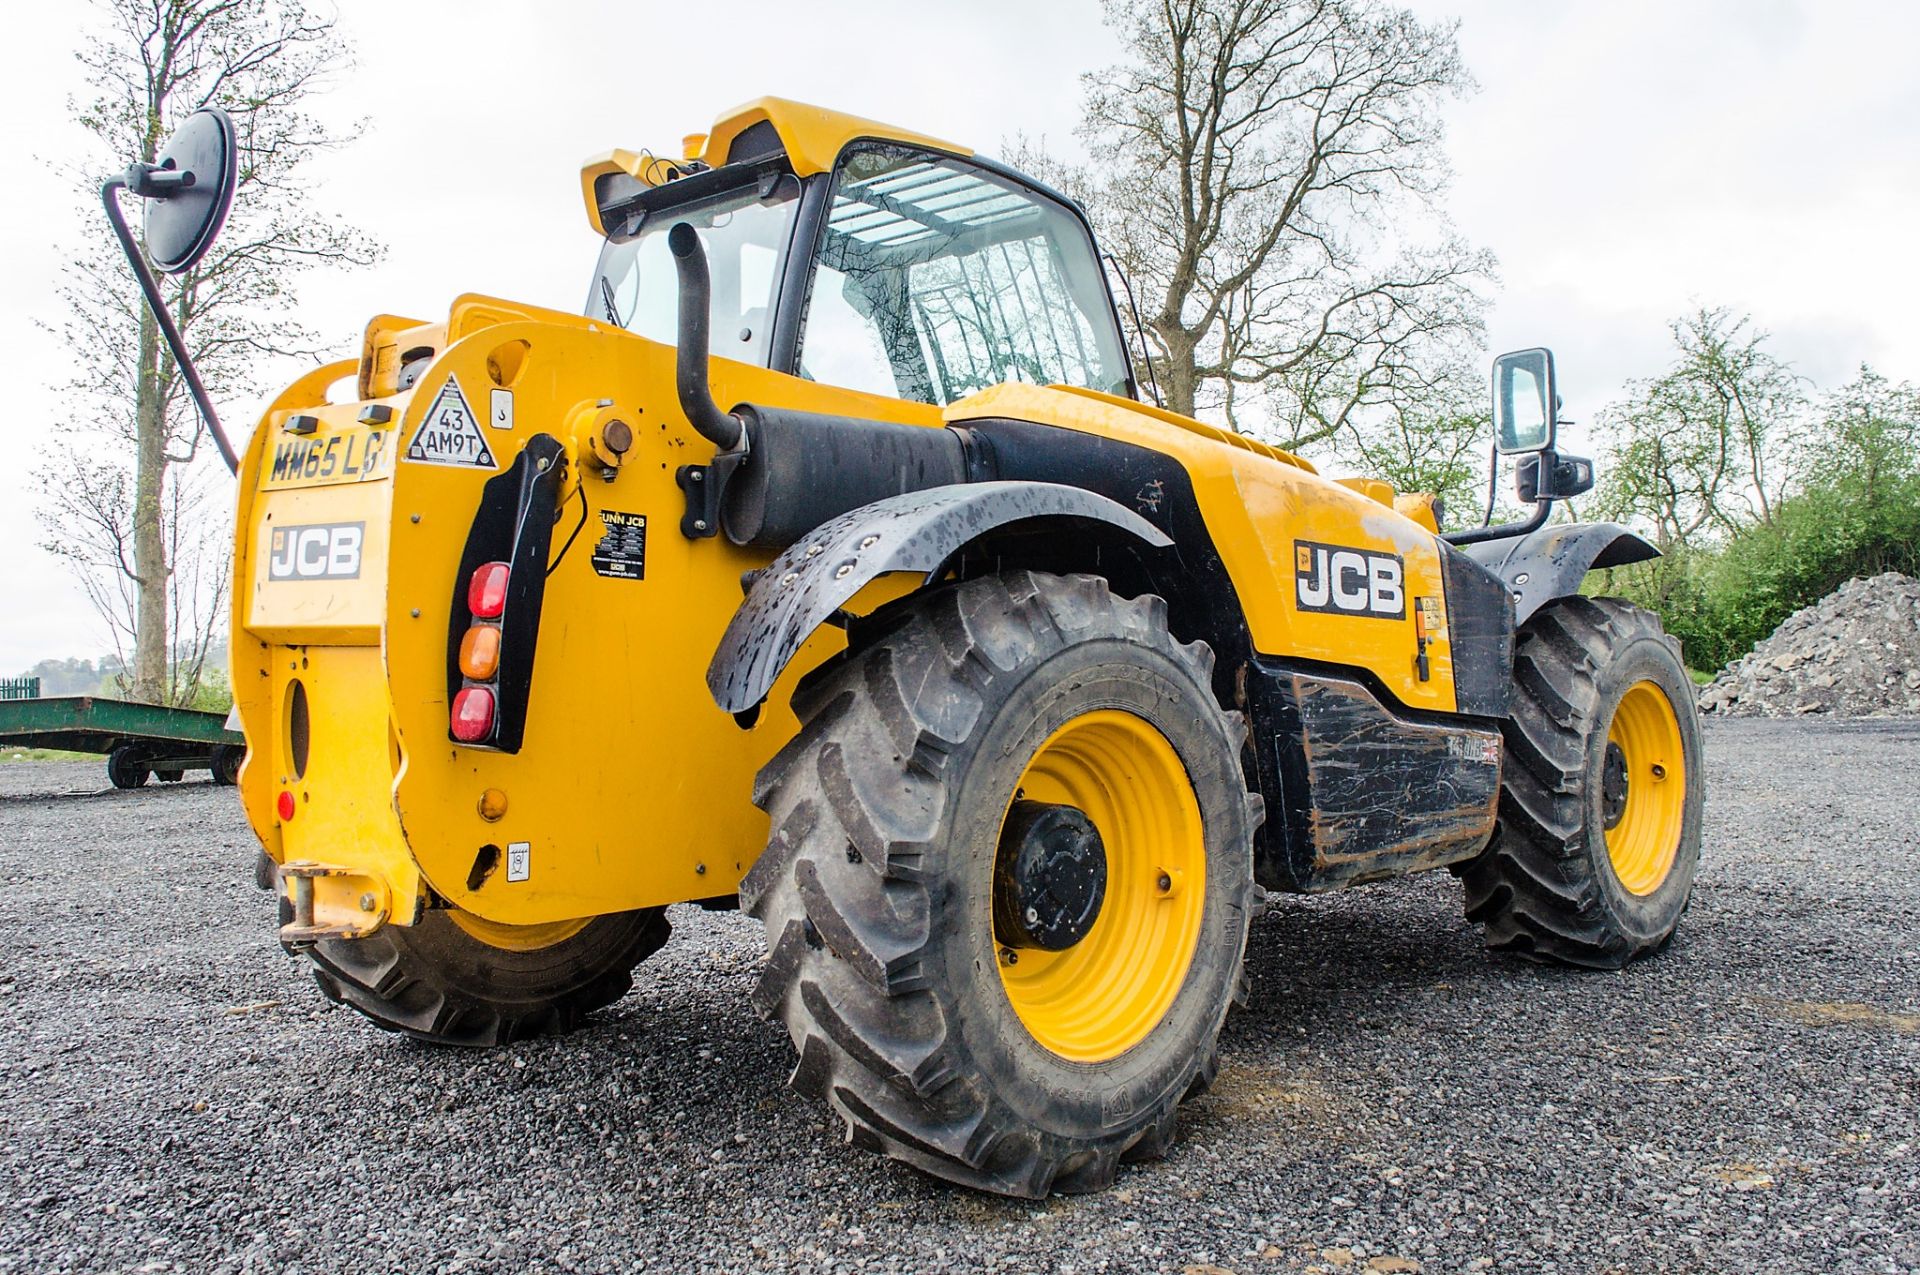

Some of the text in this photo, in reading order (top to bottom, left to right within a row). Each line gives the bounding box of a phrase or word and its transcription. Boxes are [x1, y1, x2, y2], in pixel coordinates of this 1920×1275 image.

[439, 408, 464, 431] 43
[270, 435, 341, 482] MM65
[426, 430, 477, 457] AM9T
[599, 512, 644, 527] UNN JCB
[271, 526, 362, 577] JCB
[1297, 547, 1404, 614] JCB
